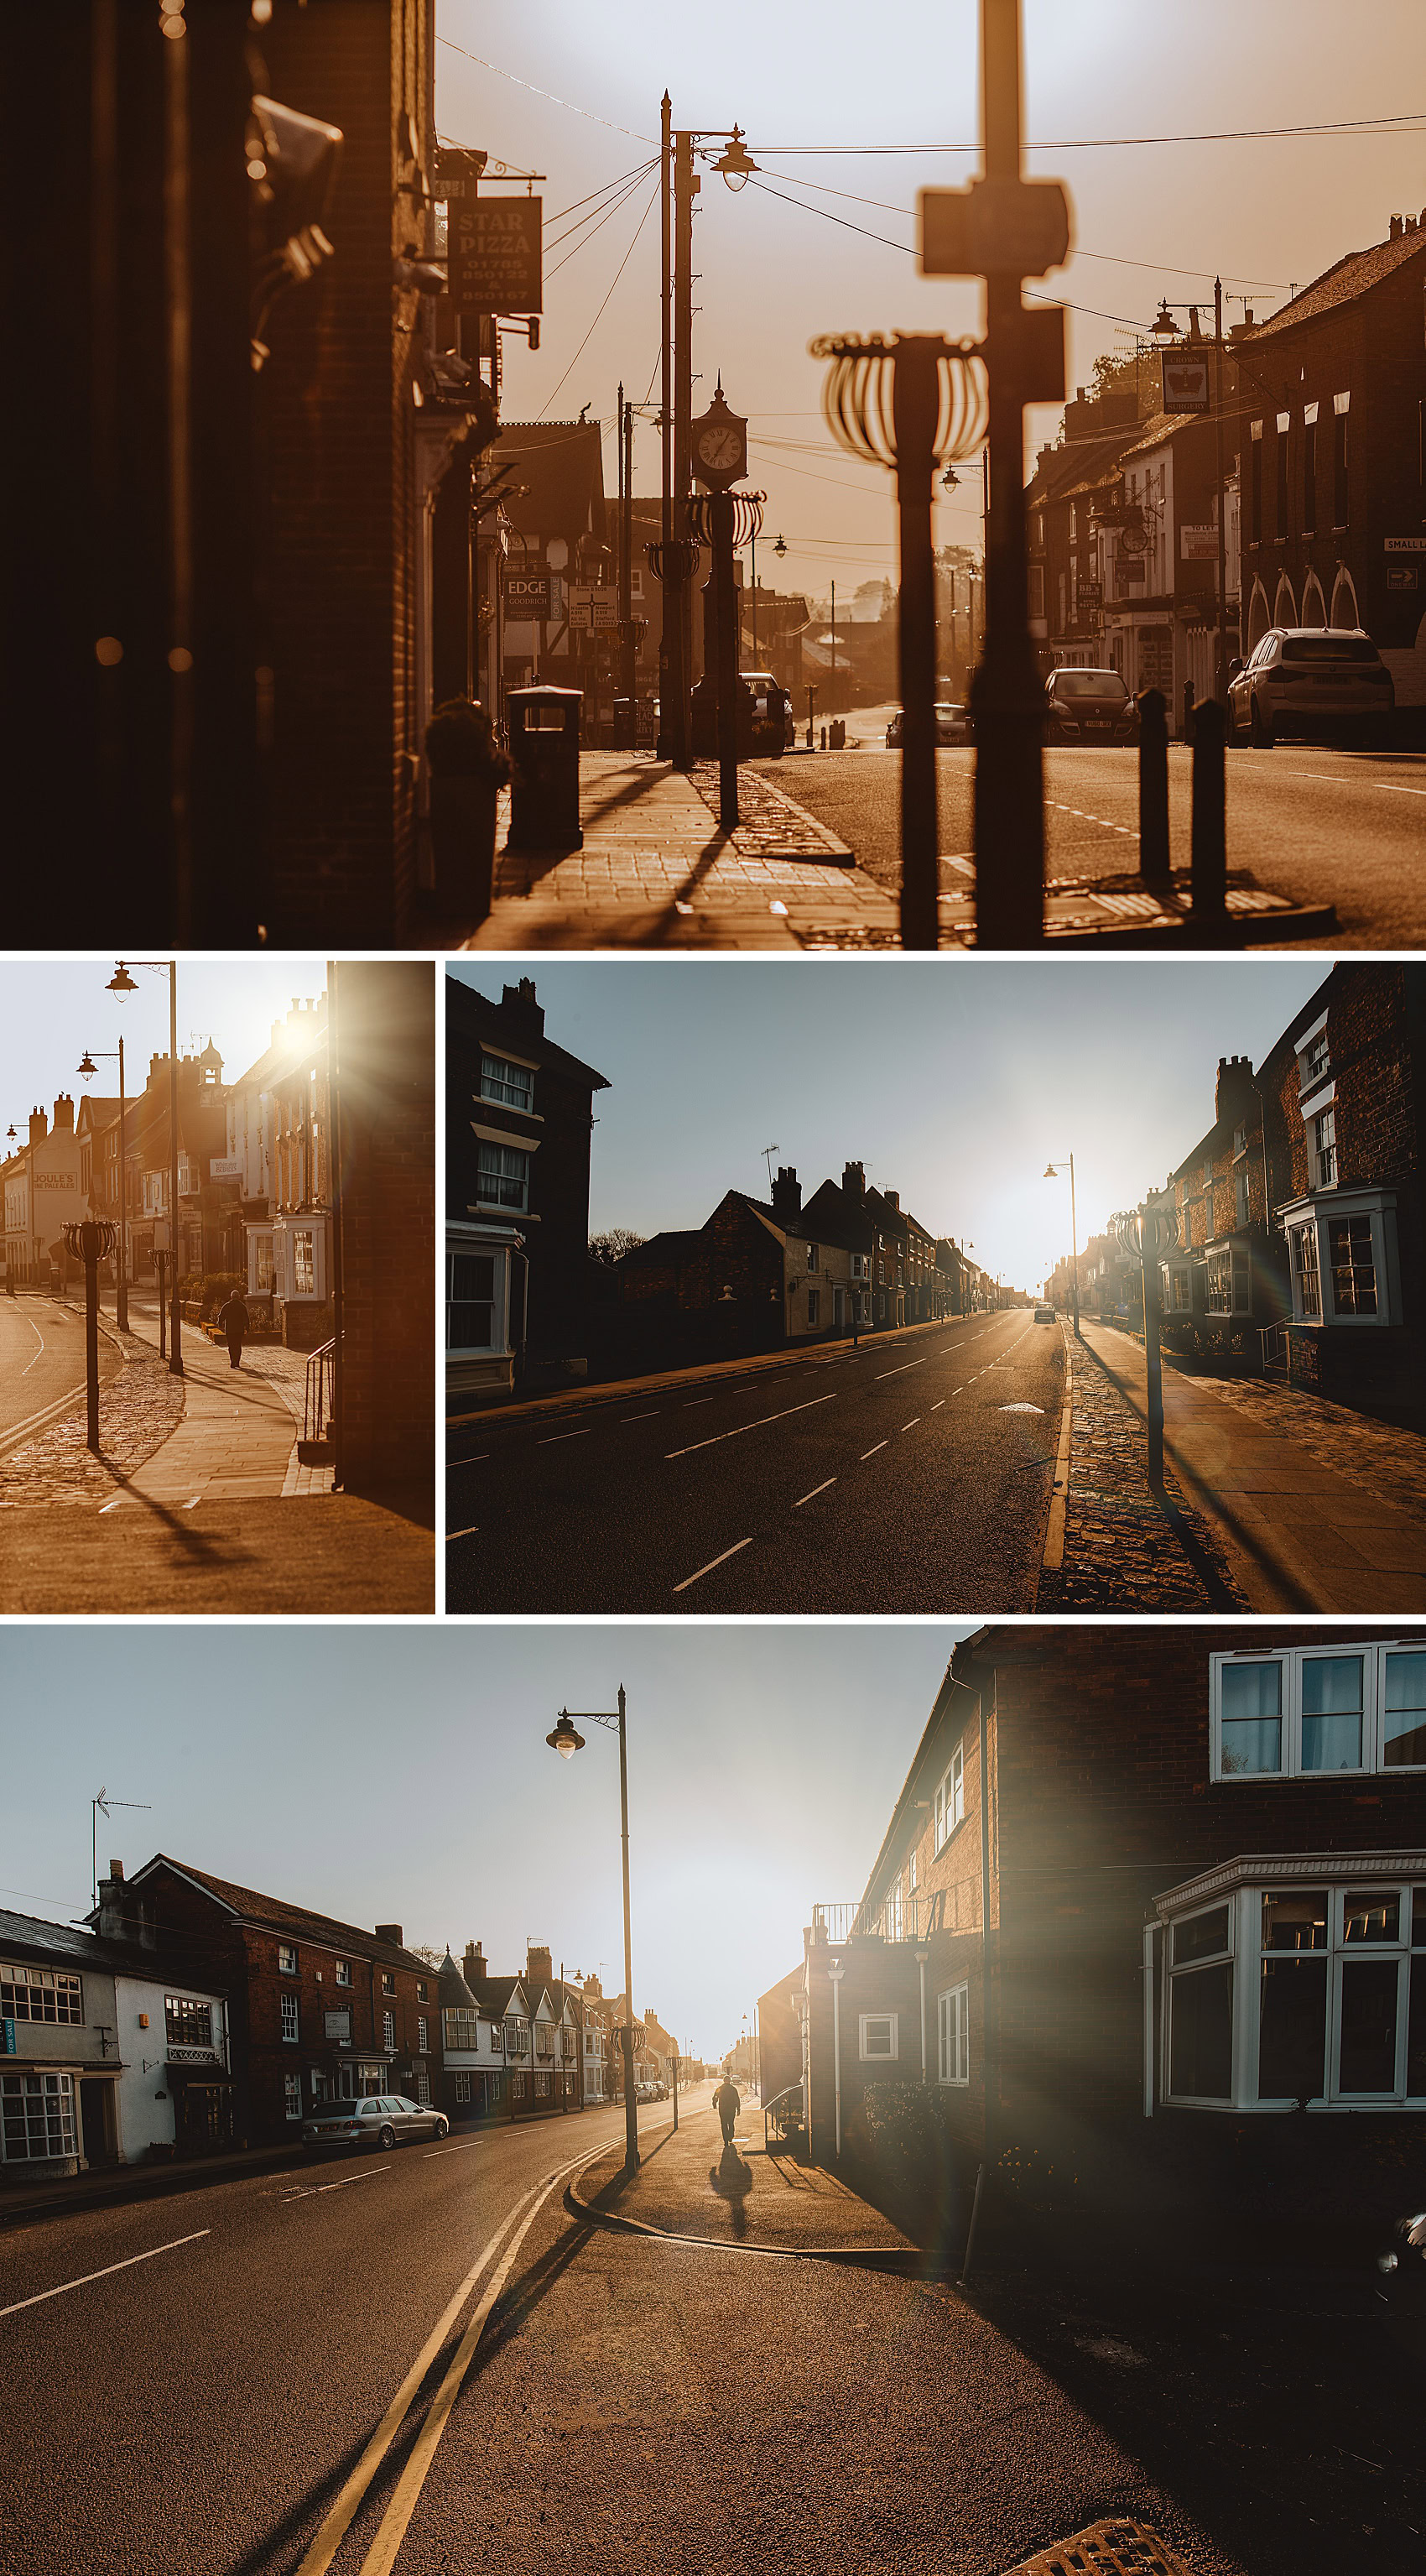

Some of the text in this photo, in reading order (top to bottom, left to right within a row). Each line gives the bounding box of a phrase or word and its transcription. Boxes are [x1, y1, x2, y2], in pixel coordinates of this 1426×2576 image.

[458, 213, 523, 231] STAR
[459, 236, 531, 253] PIZZA
[1388, 540, 1426, 549] SMALL L
[508, 581, 546, 594] EDGE
[34, 1174, 74, 1183] JOULE'S
